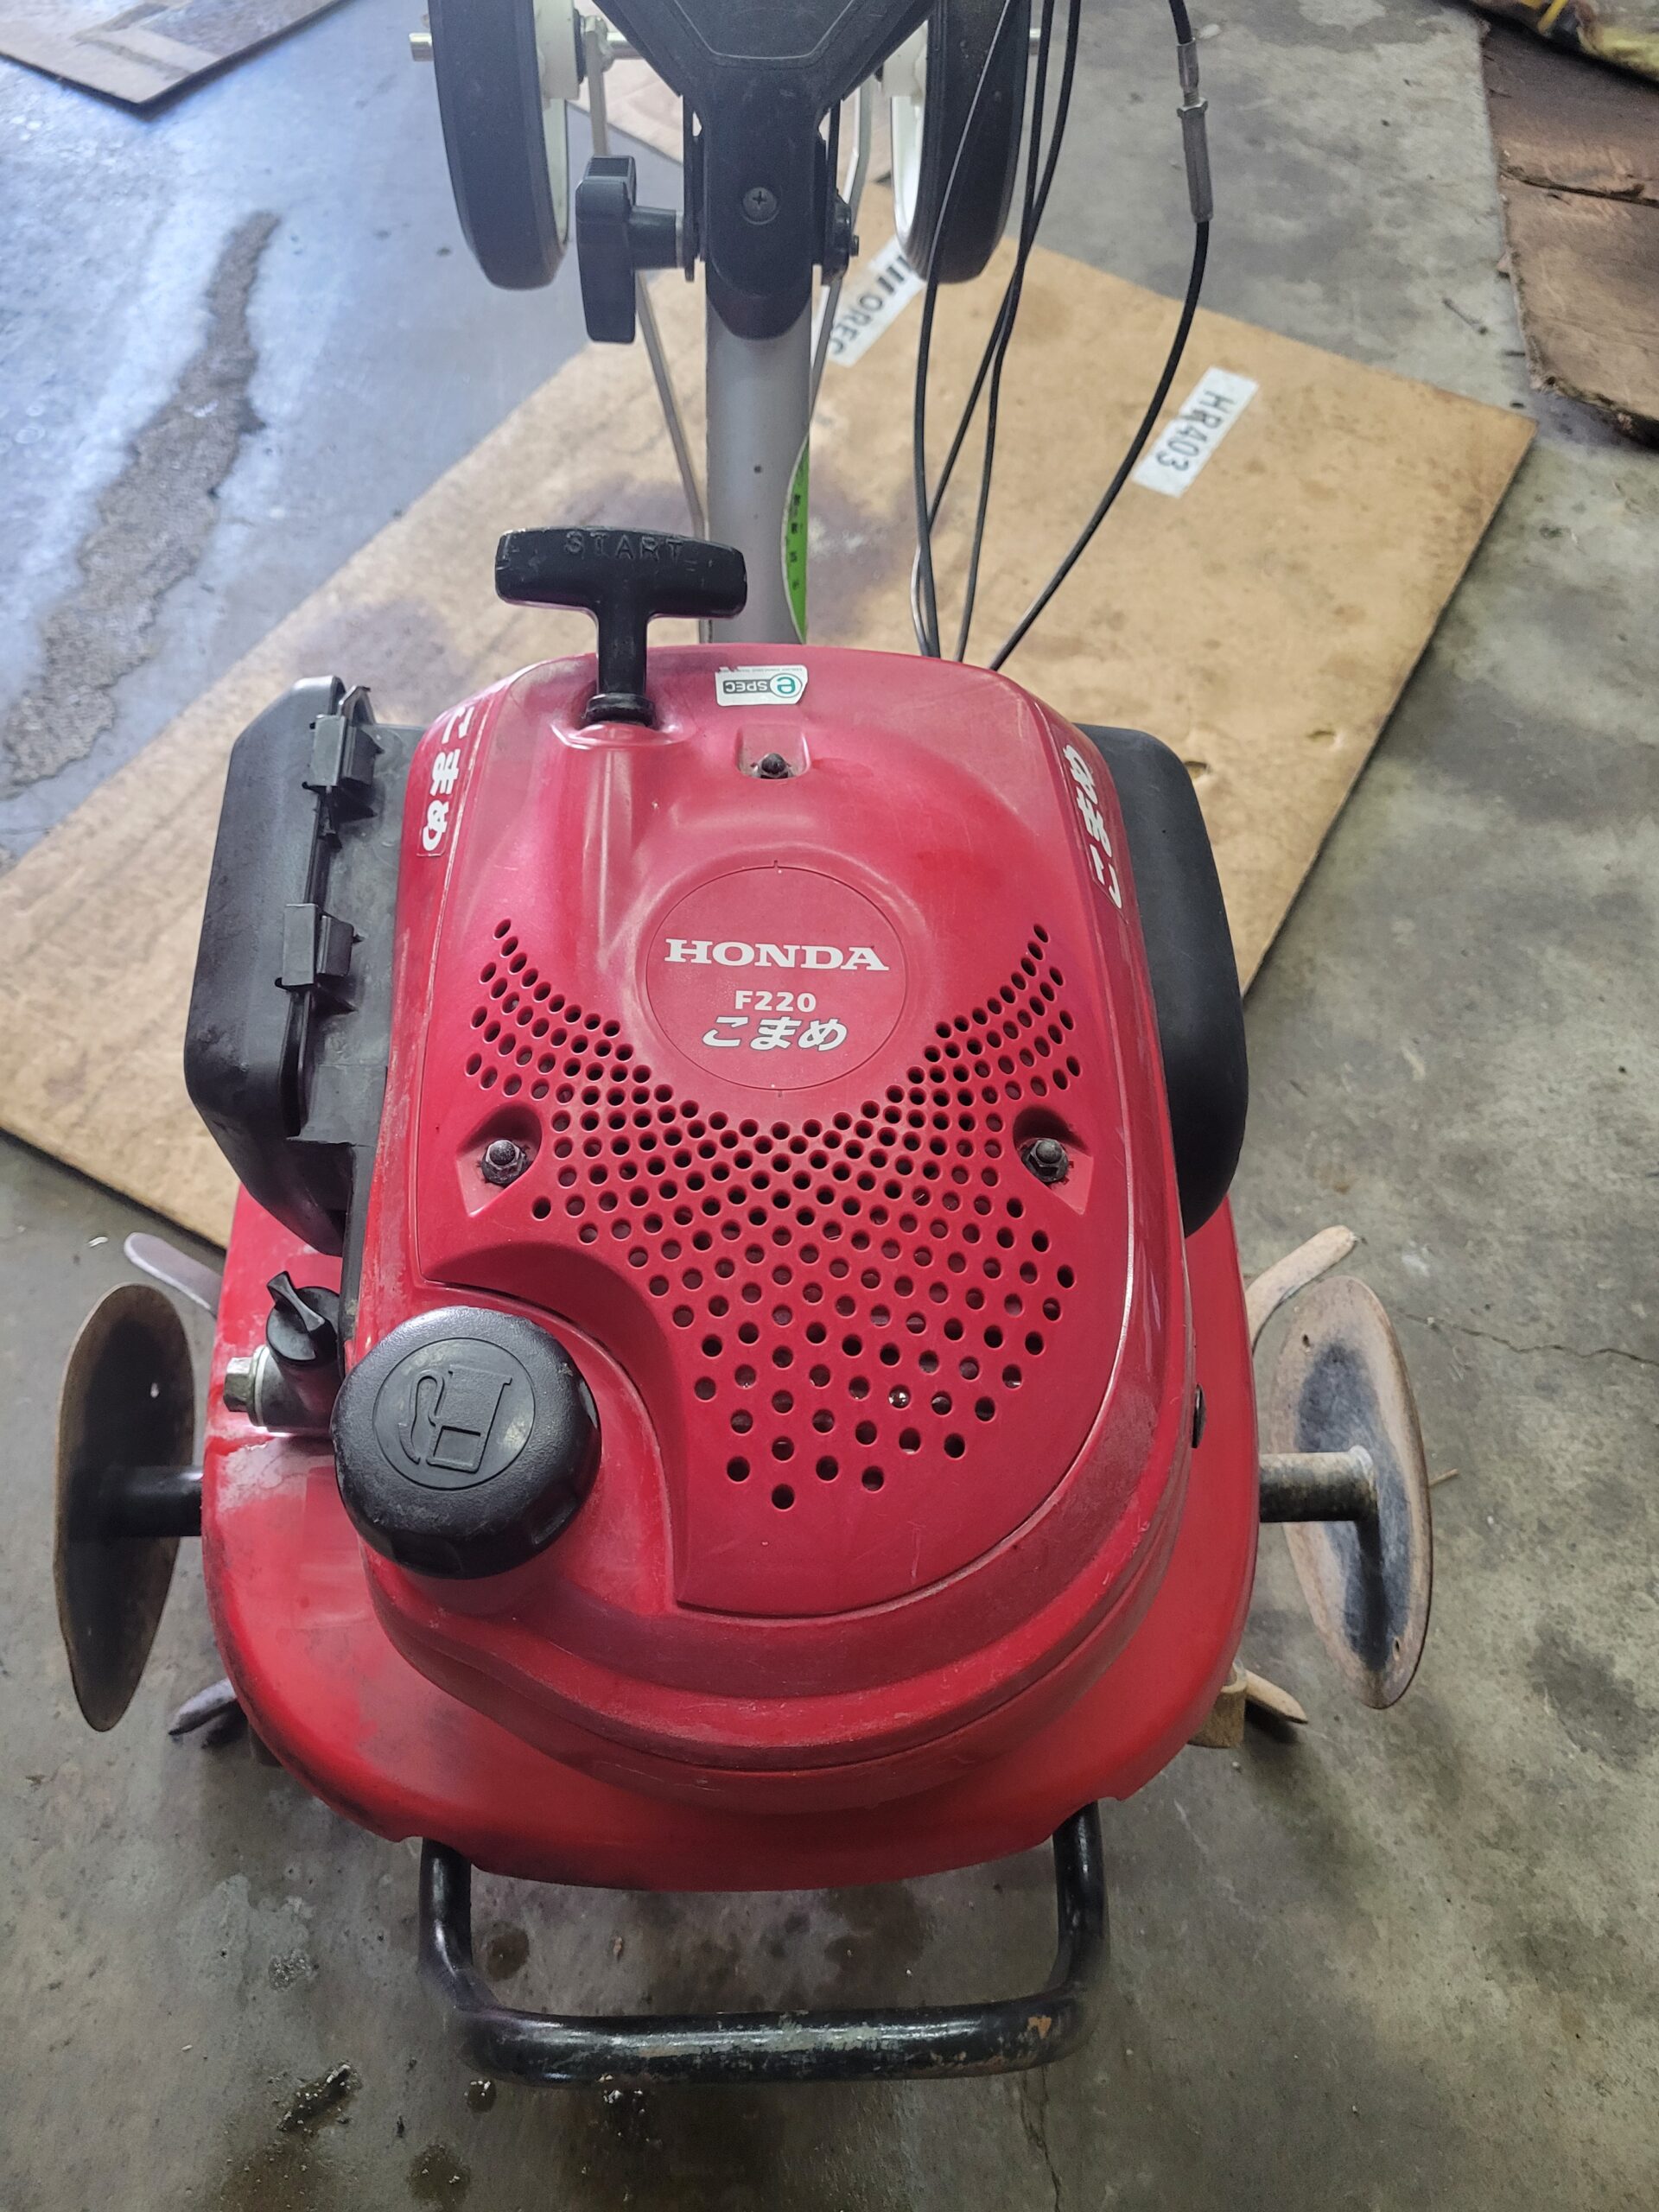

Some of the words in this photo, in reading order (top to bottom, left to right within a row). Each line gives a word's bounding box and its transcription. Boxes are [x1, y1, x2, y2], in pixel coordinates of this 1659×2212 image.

[1155, 390, 1236, 472] HR403
[565, 531, 685, 563] START
[724, 680, 768, 693] SPEC
[422, 706, 475, 851] こまめ
[1062, 744, 1122, 909] こまめ
[664, 938, 890, 971] HONDA
[734, 989, 817, 1013] F220
[702, 1015, 848, 1052] こまめ
